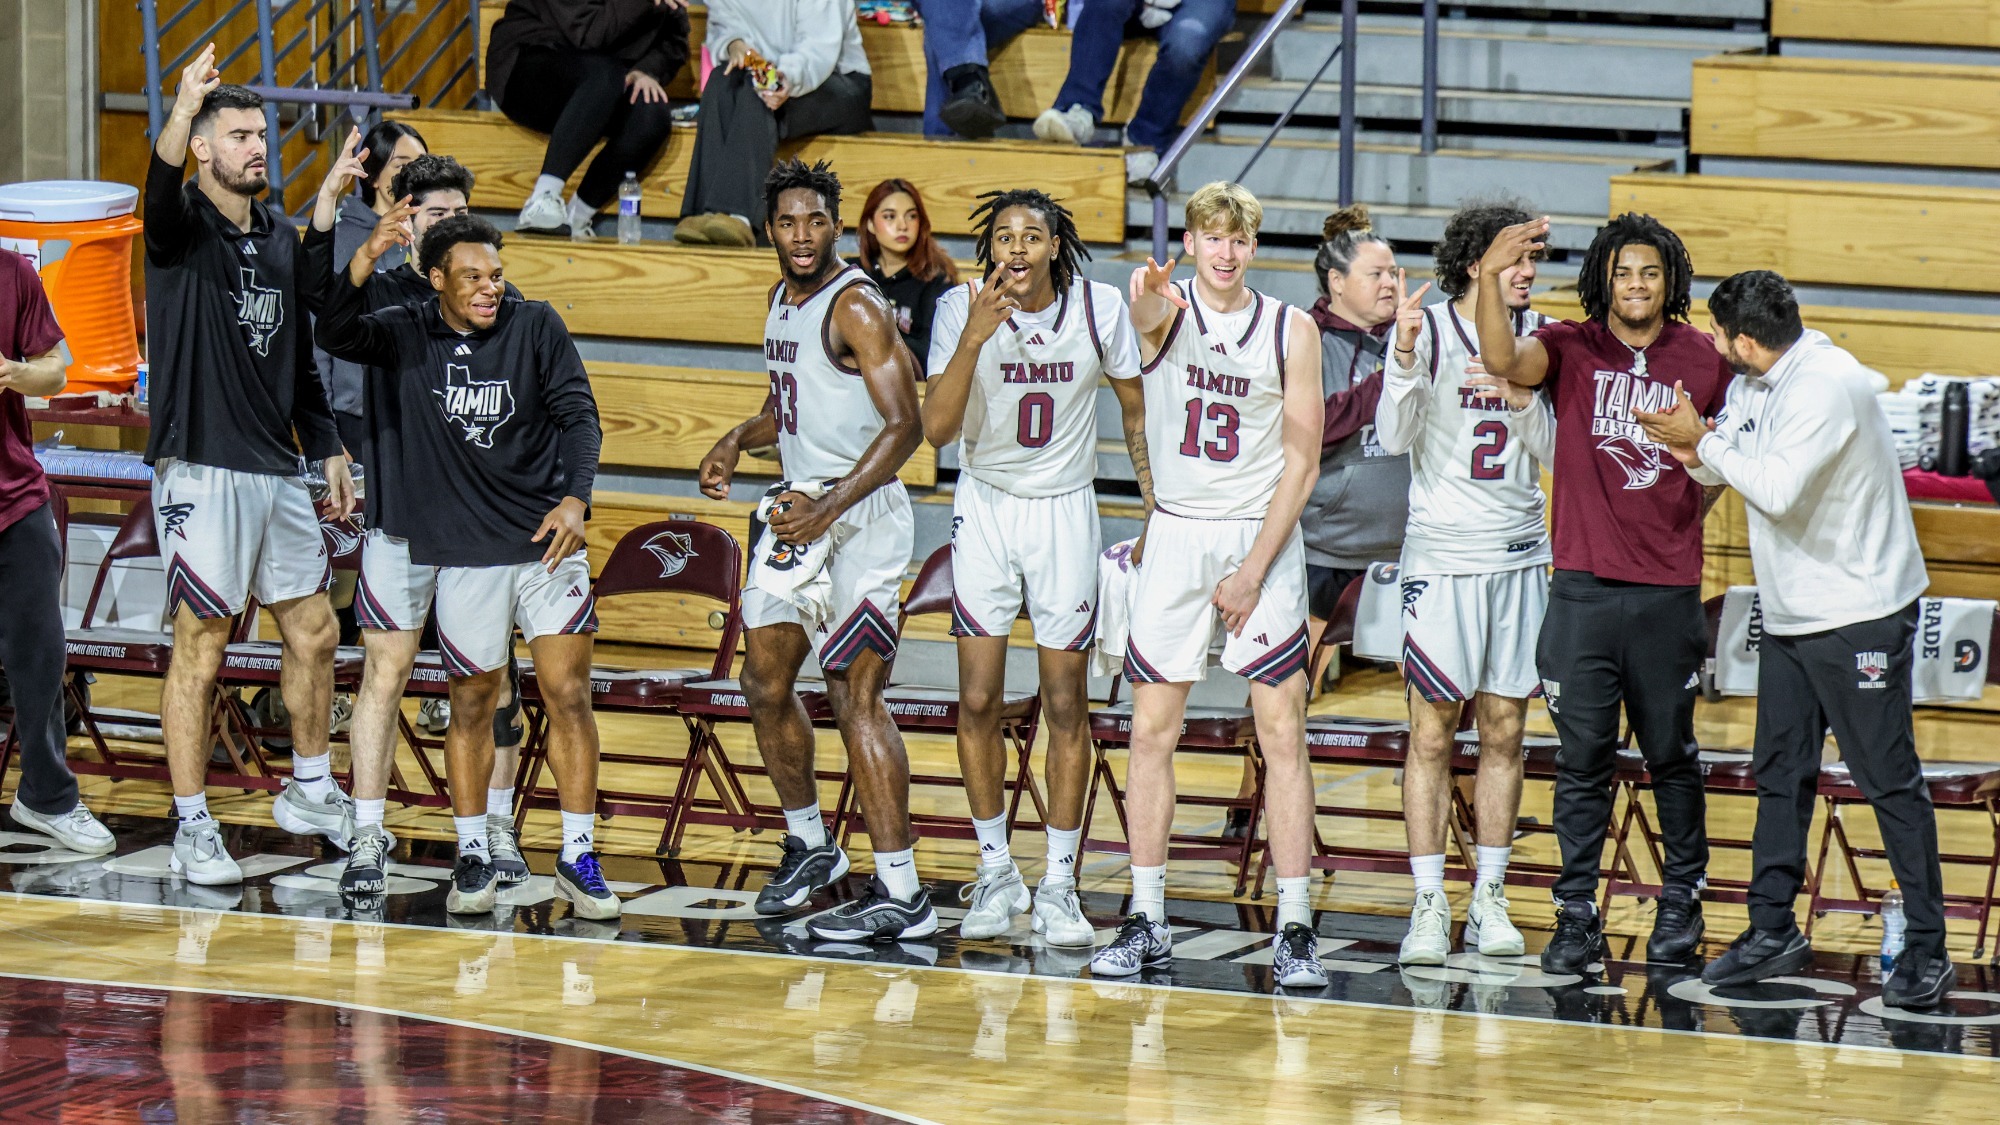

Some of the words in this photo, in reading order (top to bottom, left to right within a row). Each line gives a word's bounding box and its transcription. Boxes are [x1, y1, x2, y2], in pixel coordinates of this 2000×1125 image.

[239, 290, 277, 323] TAMIU
[766, 338, 799, 363] TAMIU
[1000, 361, 1074, 383] TAMIU
[1187, 364, 1251, 398] TAMIU
[446, 385, 503, 415] TAMIU
[1017, 392, 1055, 448] 0
[1180, 397, 1240, 462] 13
[1471, 420, 1508, 479] 2
[86, 644, 127, 658] DUSTDEVILS
[1855, 651, 1888, 669] TAMIU
[226, 655, 248, 669] TAMIU
[247, 656, 281, 671] DUSTDEVI
[413, 667, 449, 682] DUSTDEVIL
[710, 693, 732, 706] TAMIU
[904, 703, 948, 717] DUSTDEVILS
[1323, 733, 1368, 748] DUSTDEVILS
